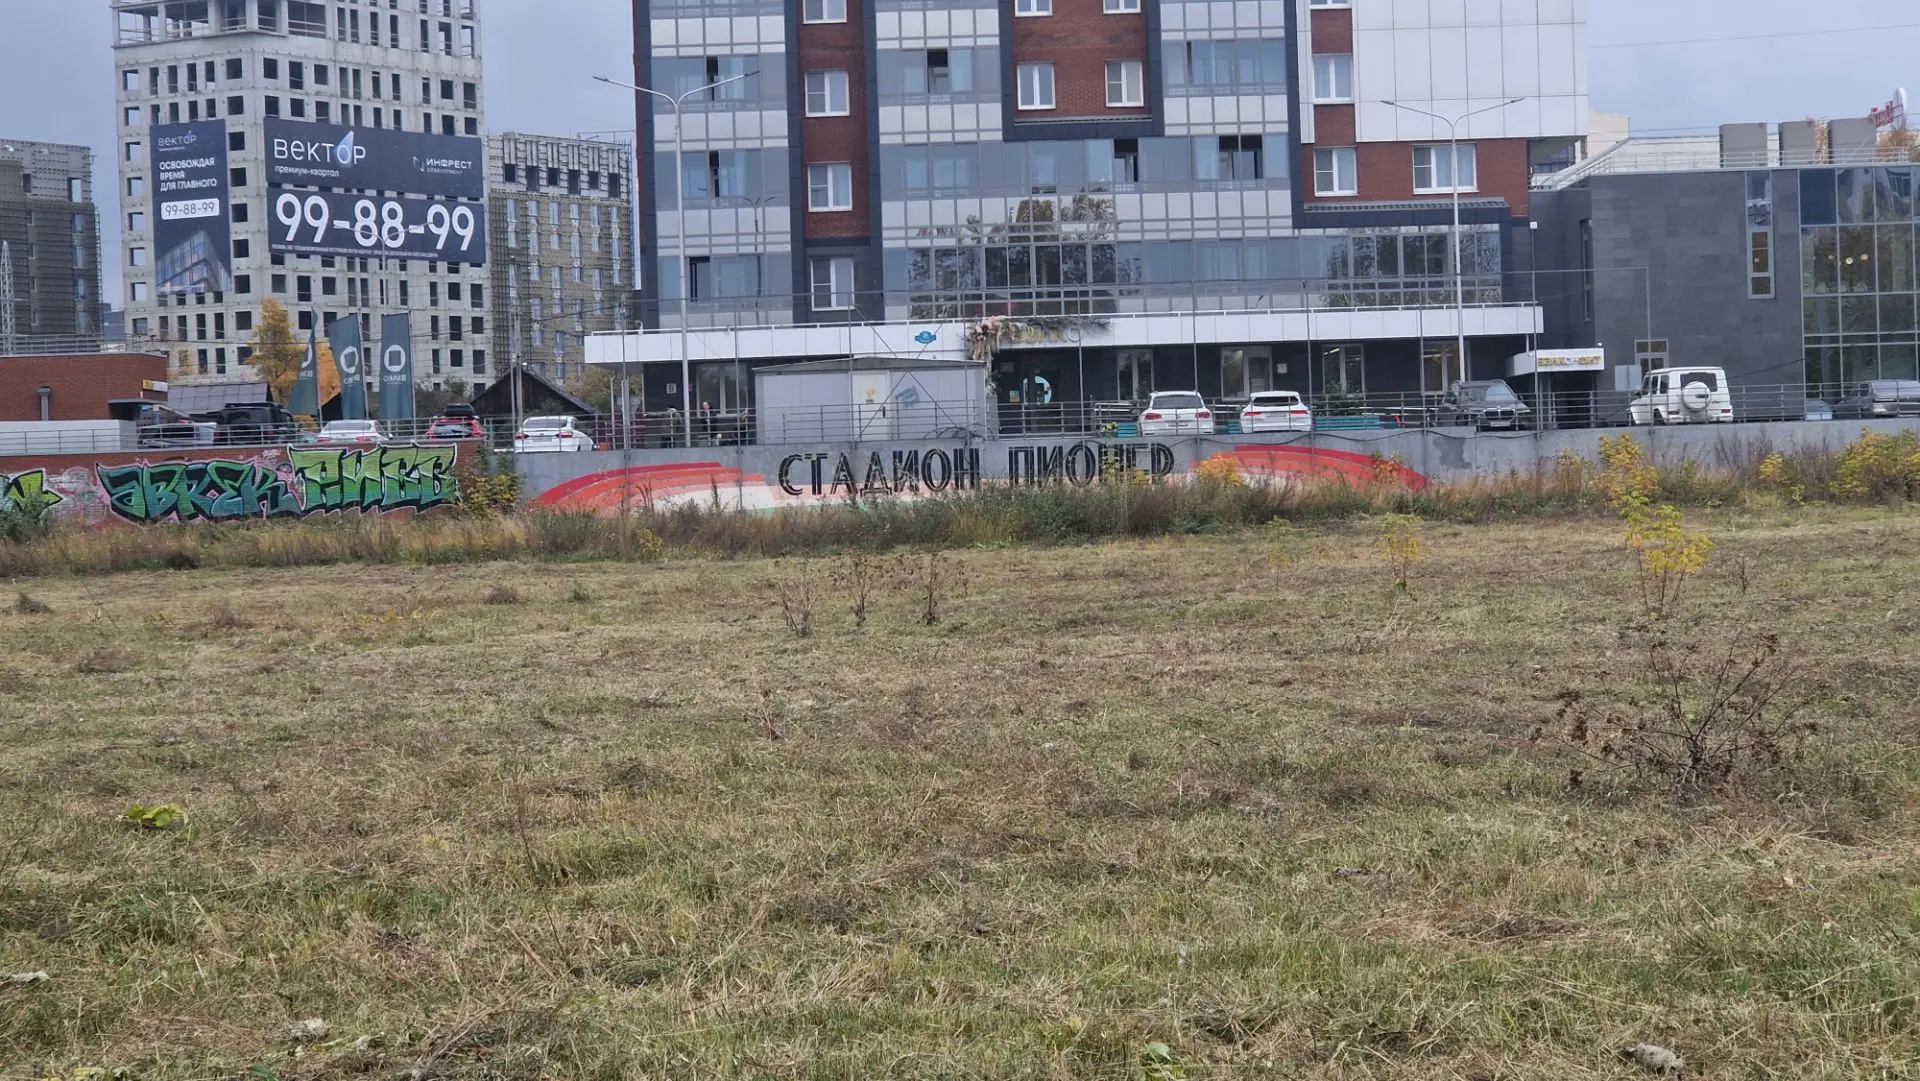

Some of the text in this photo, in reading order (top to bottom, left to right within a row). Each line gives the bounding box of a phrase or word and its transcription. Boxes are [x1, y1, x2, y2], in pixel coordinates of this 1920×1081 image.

[159, 157, 215, 170] ОСВОБОЖДАЯ
[426, 157, 472, 169] ИНФРЕСТ
[160, 171, 185, 181] ВРЕМЯ
[274, 165, 340, 177] премиум-квартал
[160, 178, 218, 192] ДЛЯ ГЛАВНОГО
[165, 201, 215, 217] 99-88-99
[276, 193, 475, 251] 99-88-99
[778, 448, 980, 497] СТАДИОН
